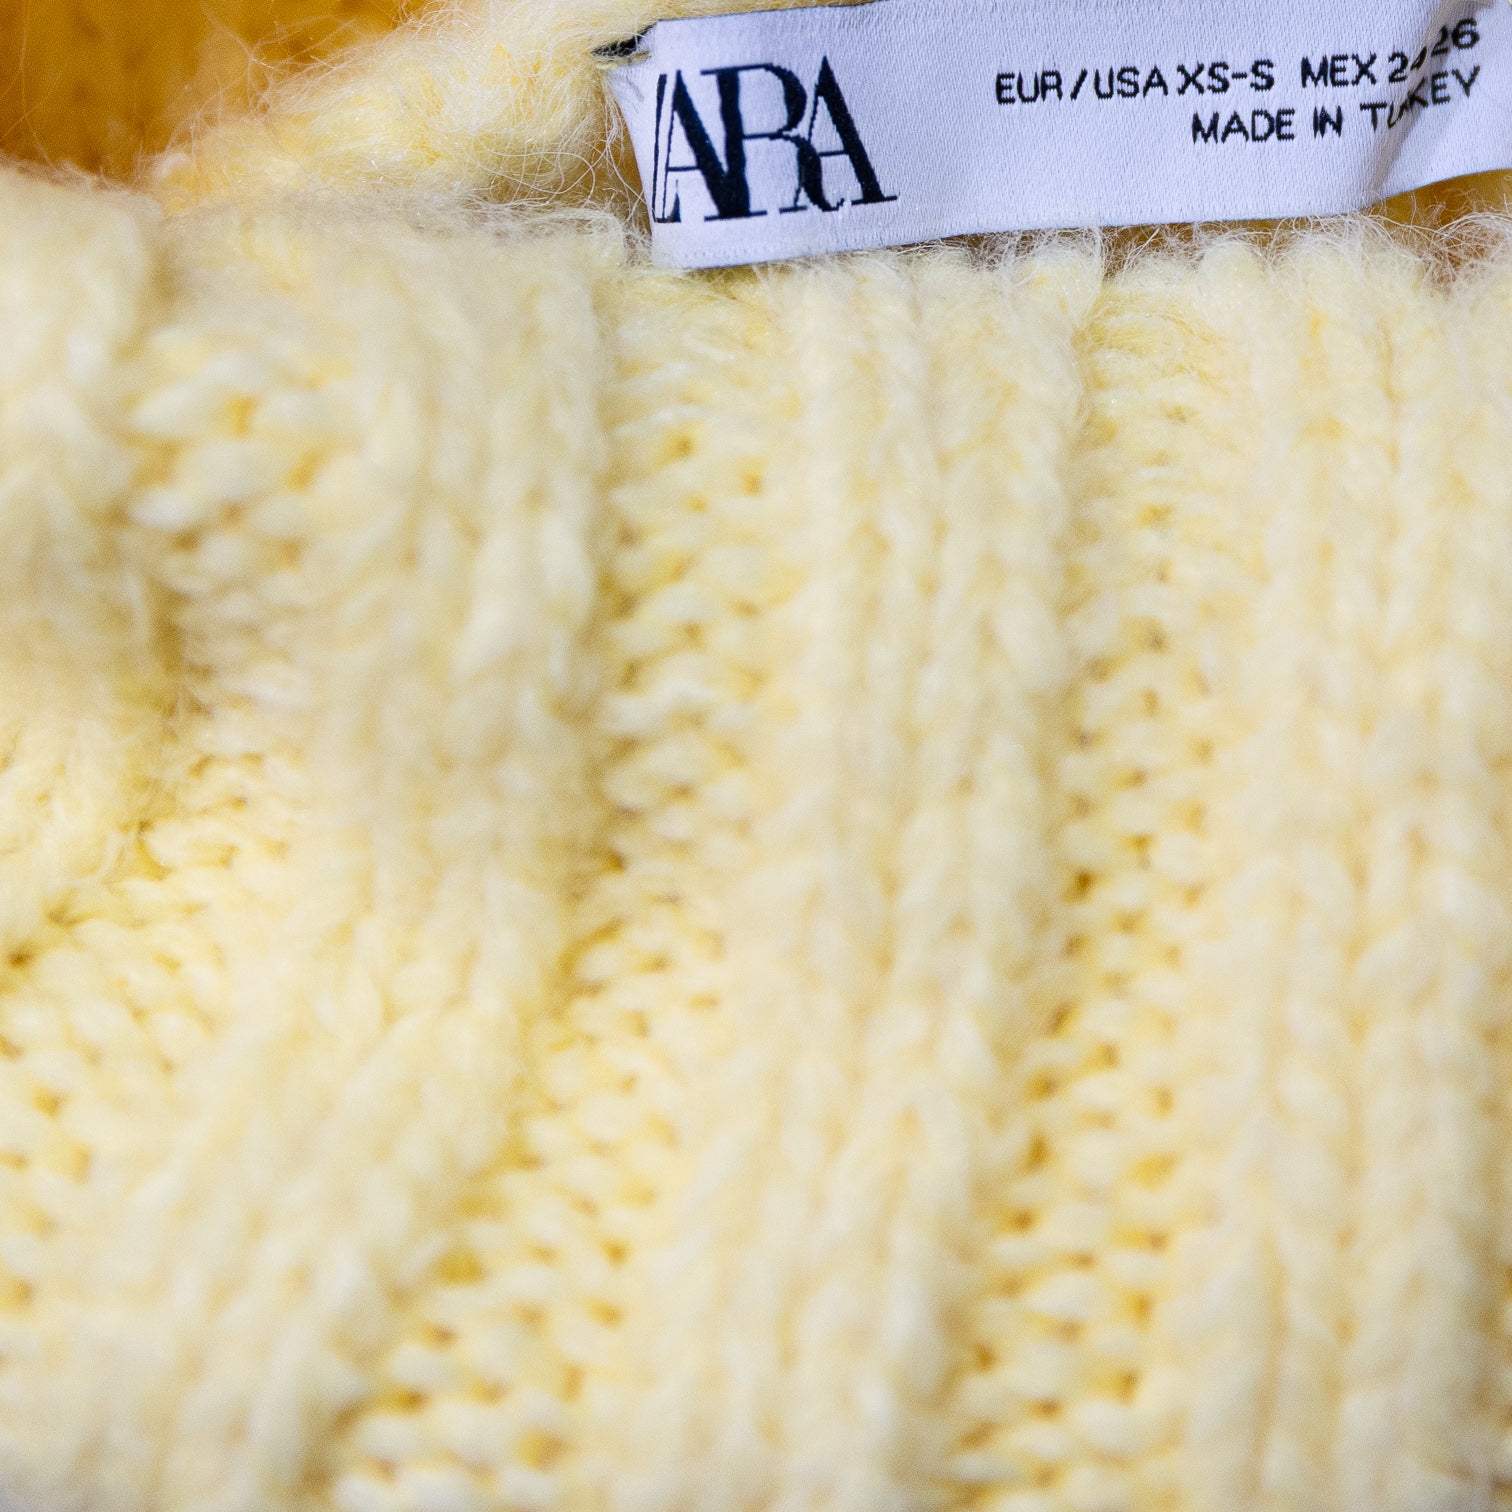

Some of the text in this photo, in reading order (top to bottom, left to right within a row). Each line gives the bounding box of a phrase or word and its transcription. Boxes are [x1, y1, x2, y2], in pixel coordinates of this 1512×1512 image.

[995, 65, 1169, 105] EUR/USA
[1176, 58, 1275, 96] XS-S
[1300, 52, 1377, 89] MEX
[1191, 107, 1296, 145] MADE
[1312, 105, 1344, 139] IN
